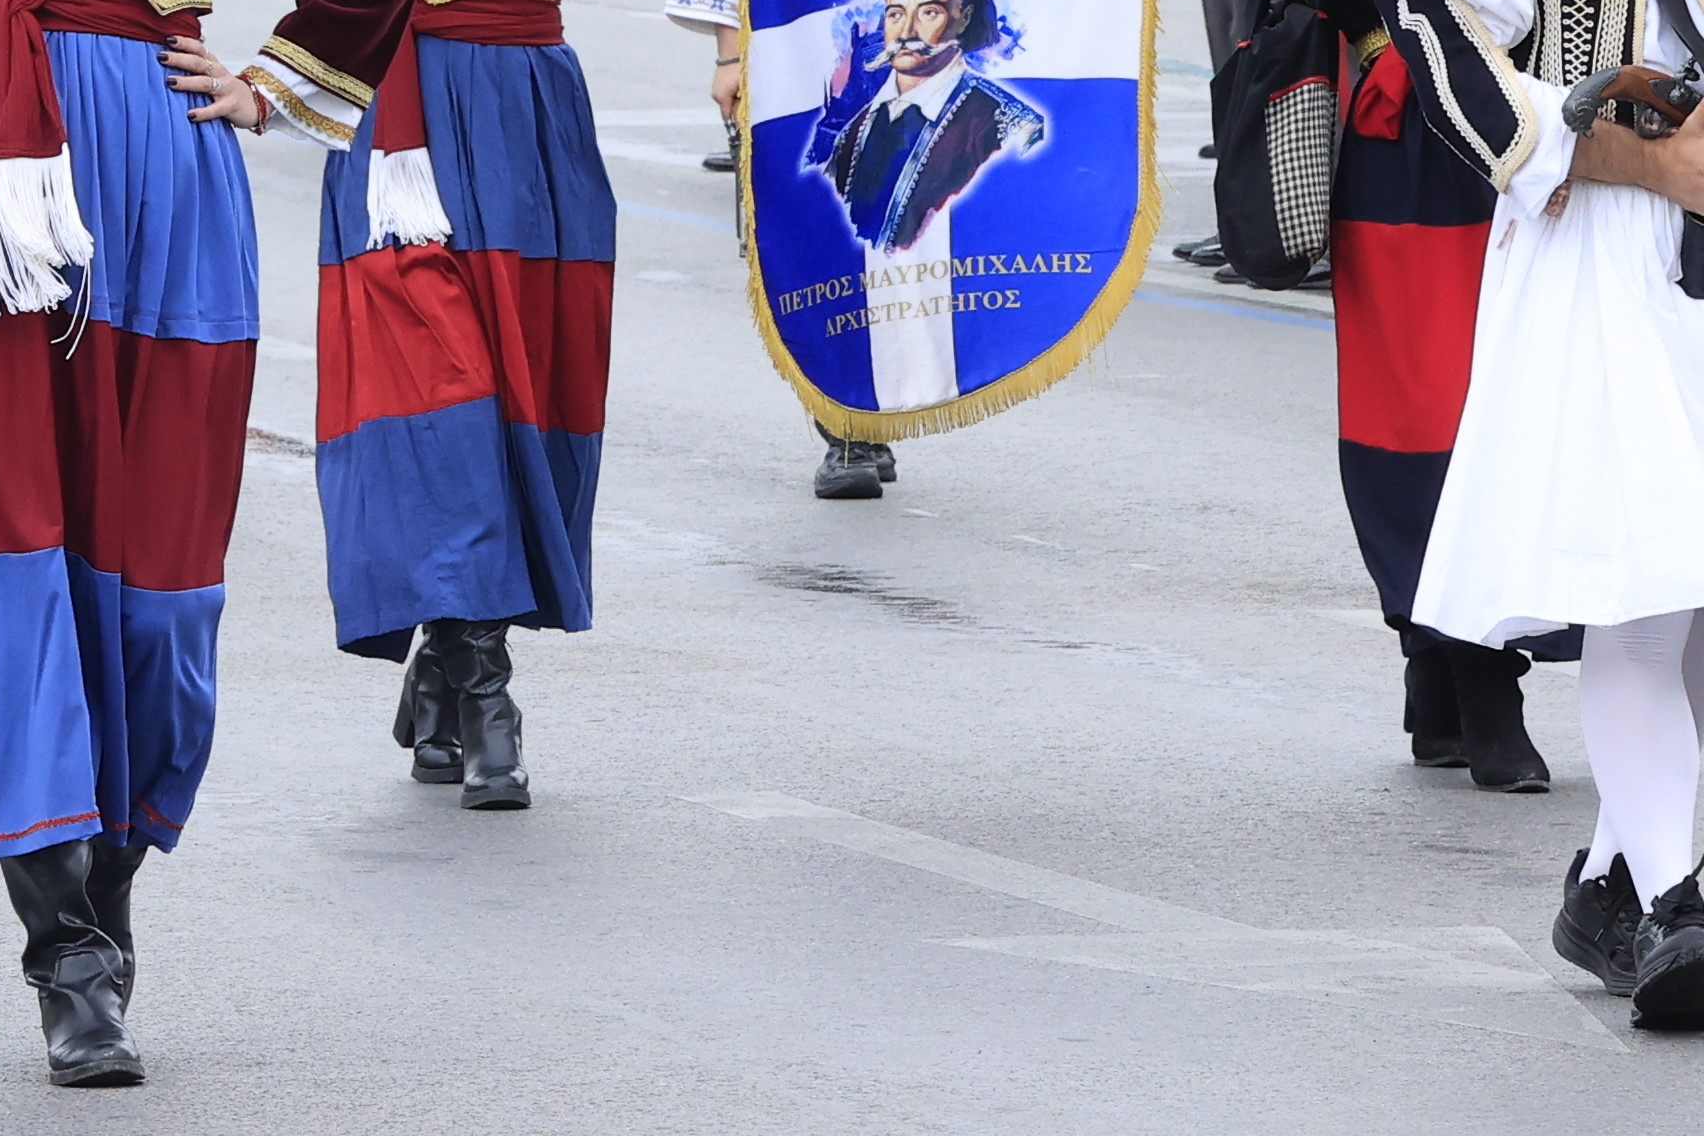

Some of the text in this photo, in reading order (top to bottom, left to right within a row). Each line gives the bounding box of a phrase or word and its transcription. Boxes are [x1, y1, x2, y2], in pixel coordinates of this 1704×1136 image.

[778, 252, 1094, 317] ΠΕΤΡΟΣ ΜΑΥΡΟΜΙΧΑΛΗΣ
[825, 289, 1023, 338] ΑΡΧΙΣΤΡΑΤΗΓΟΣ
